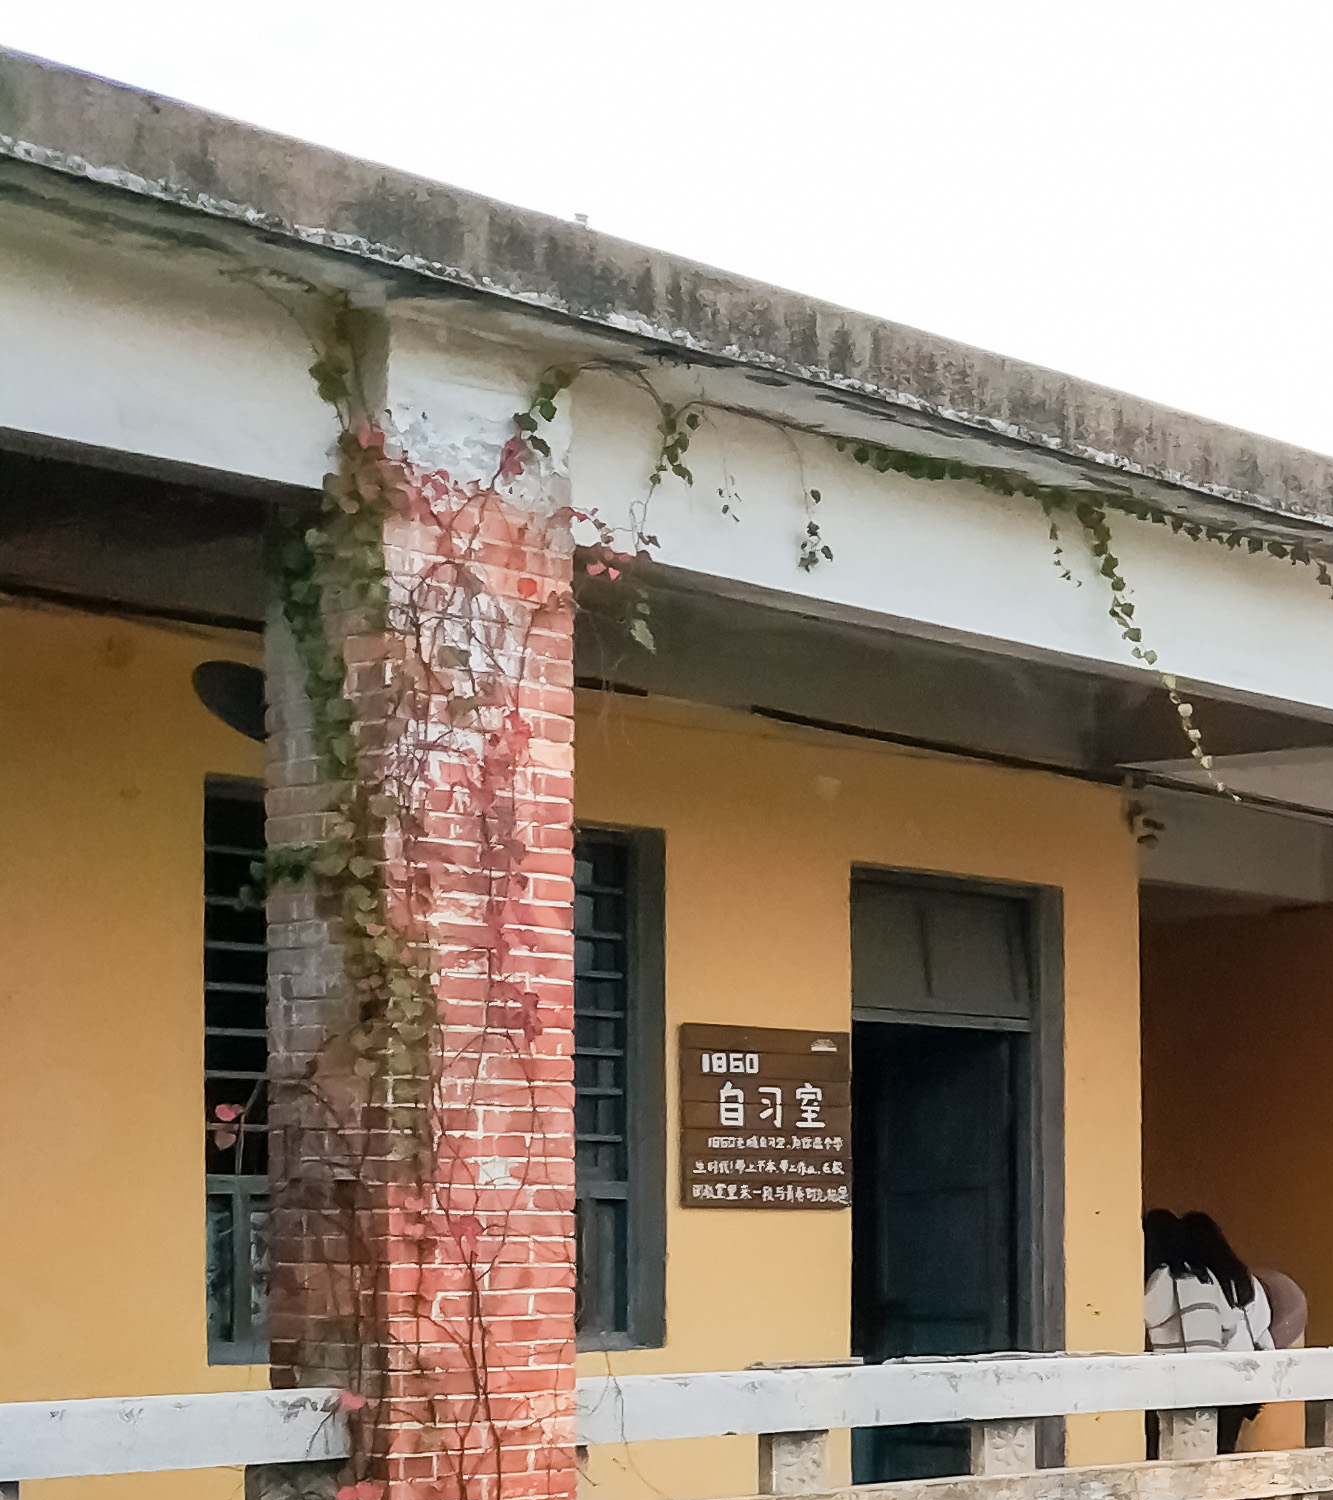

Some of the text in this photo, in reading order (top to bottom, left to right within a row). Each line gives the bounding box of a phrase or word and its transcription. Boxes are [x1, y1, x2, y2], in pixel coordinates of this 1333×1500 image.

[702, 1053, 760, 1074] 1860
[720, 1081, 826, 1129] 自习室
